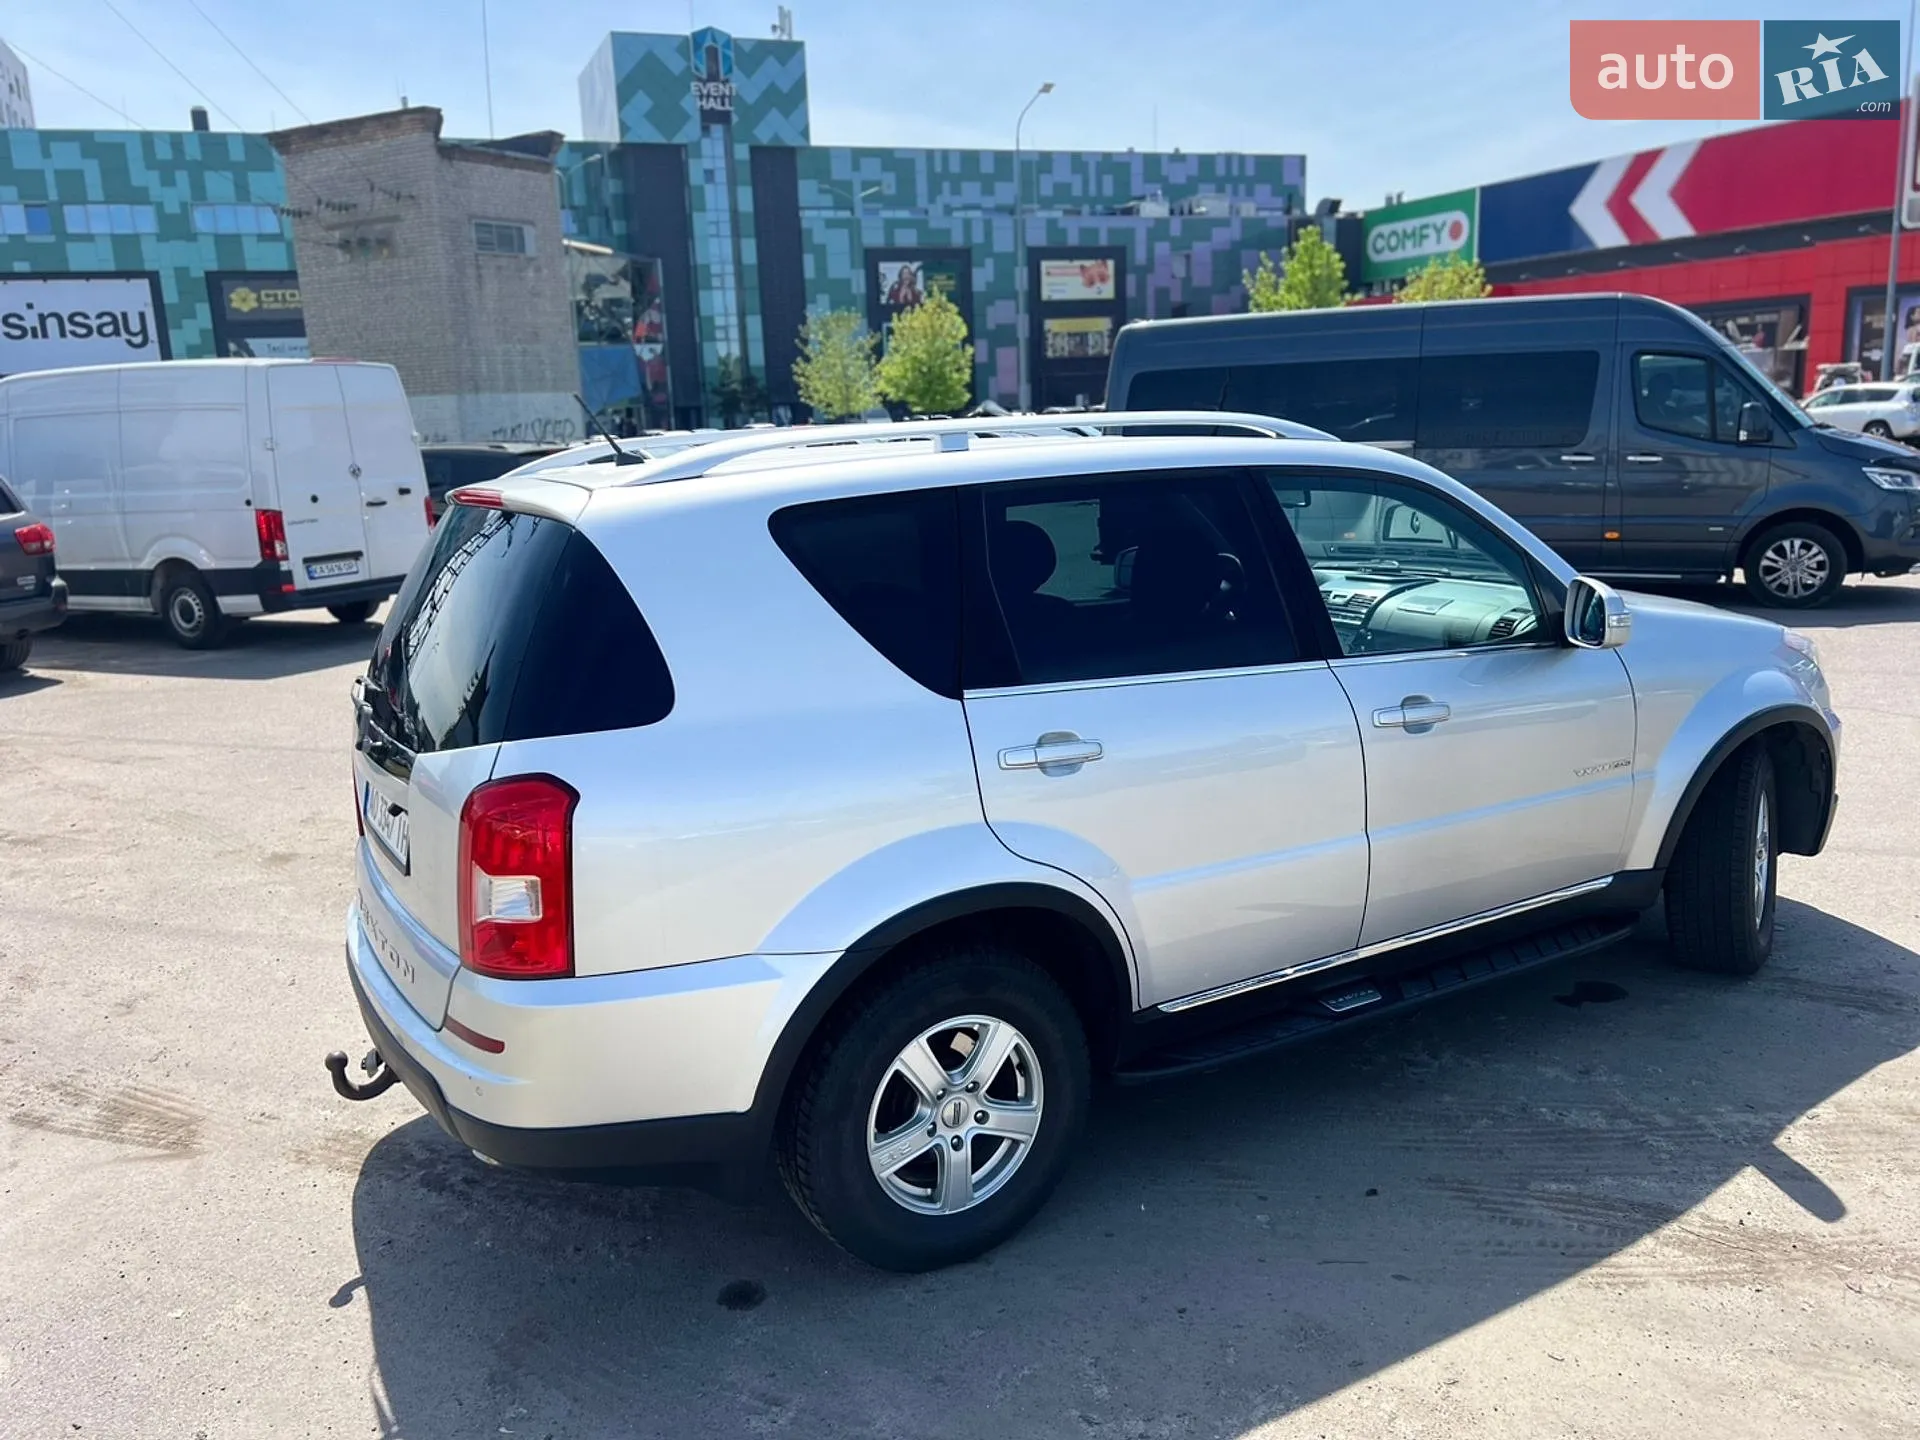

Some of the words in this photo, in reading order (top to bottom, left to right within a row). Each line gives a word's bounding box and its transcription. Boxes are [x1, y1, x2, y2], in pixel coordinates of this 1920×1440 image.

[690, 81, 736, 97] EVENT
[696, 97, 735, 111] HALL
[1372, 220, 1447, 255] COMFY
[1, 303, 149, 349] sinsay
